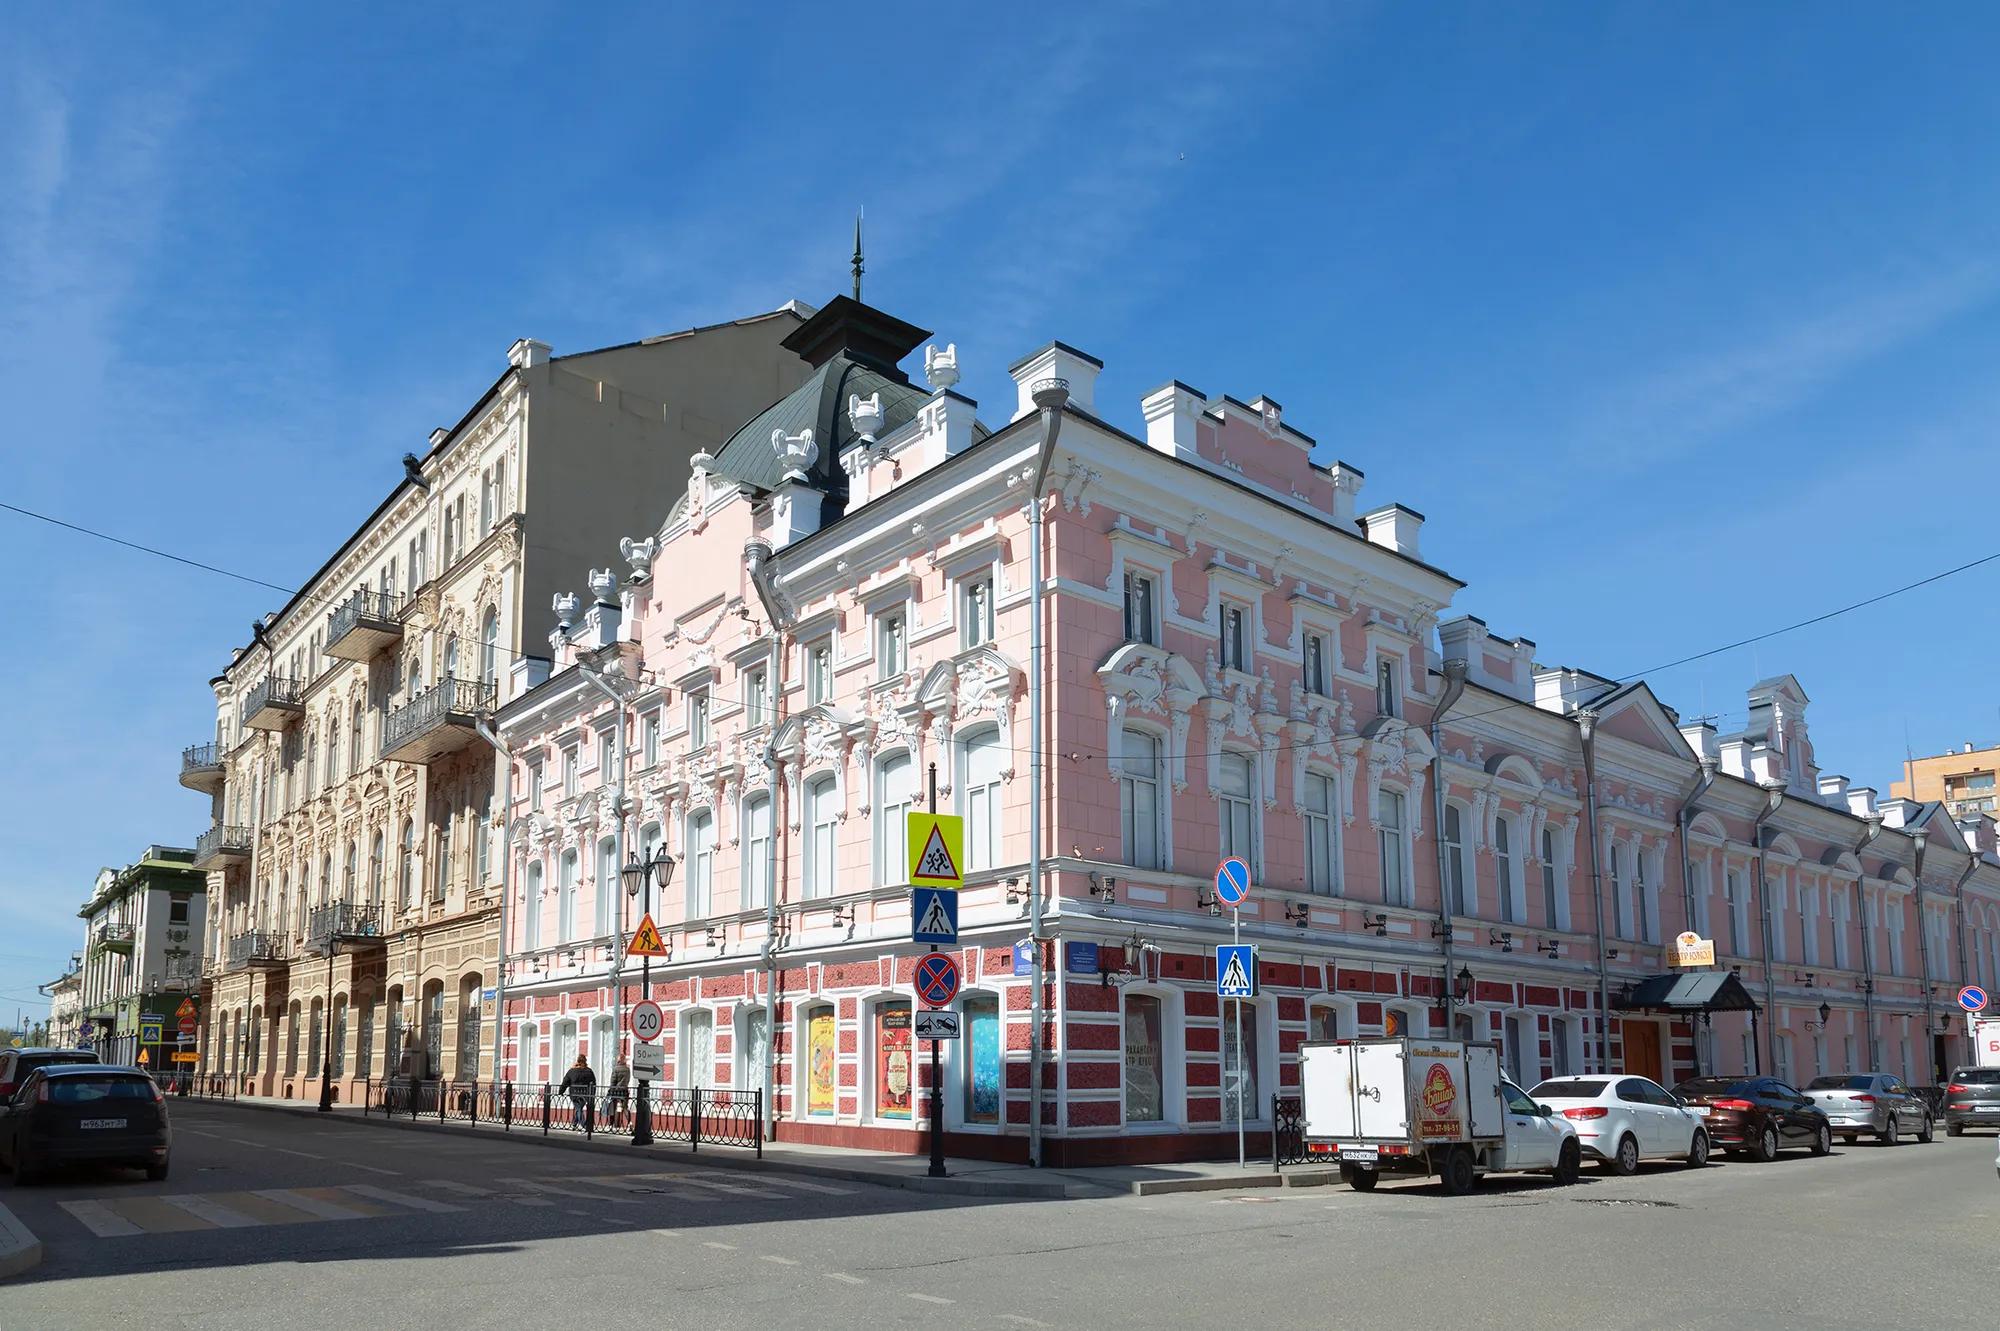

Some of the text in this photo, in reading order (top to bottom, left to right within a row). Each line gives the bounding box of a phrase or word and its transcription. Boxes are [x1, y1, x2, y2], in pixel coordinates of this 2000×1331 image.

[1668, 952, 1688, 961] ТЕАТР
[639, 1013, 657, 1029] 20
[637, 1050, 647, 1058] 50
